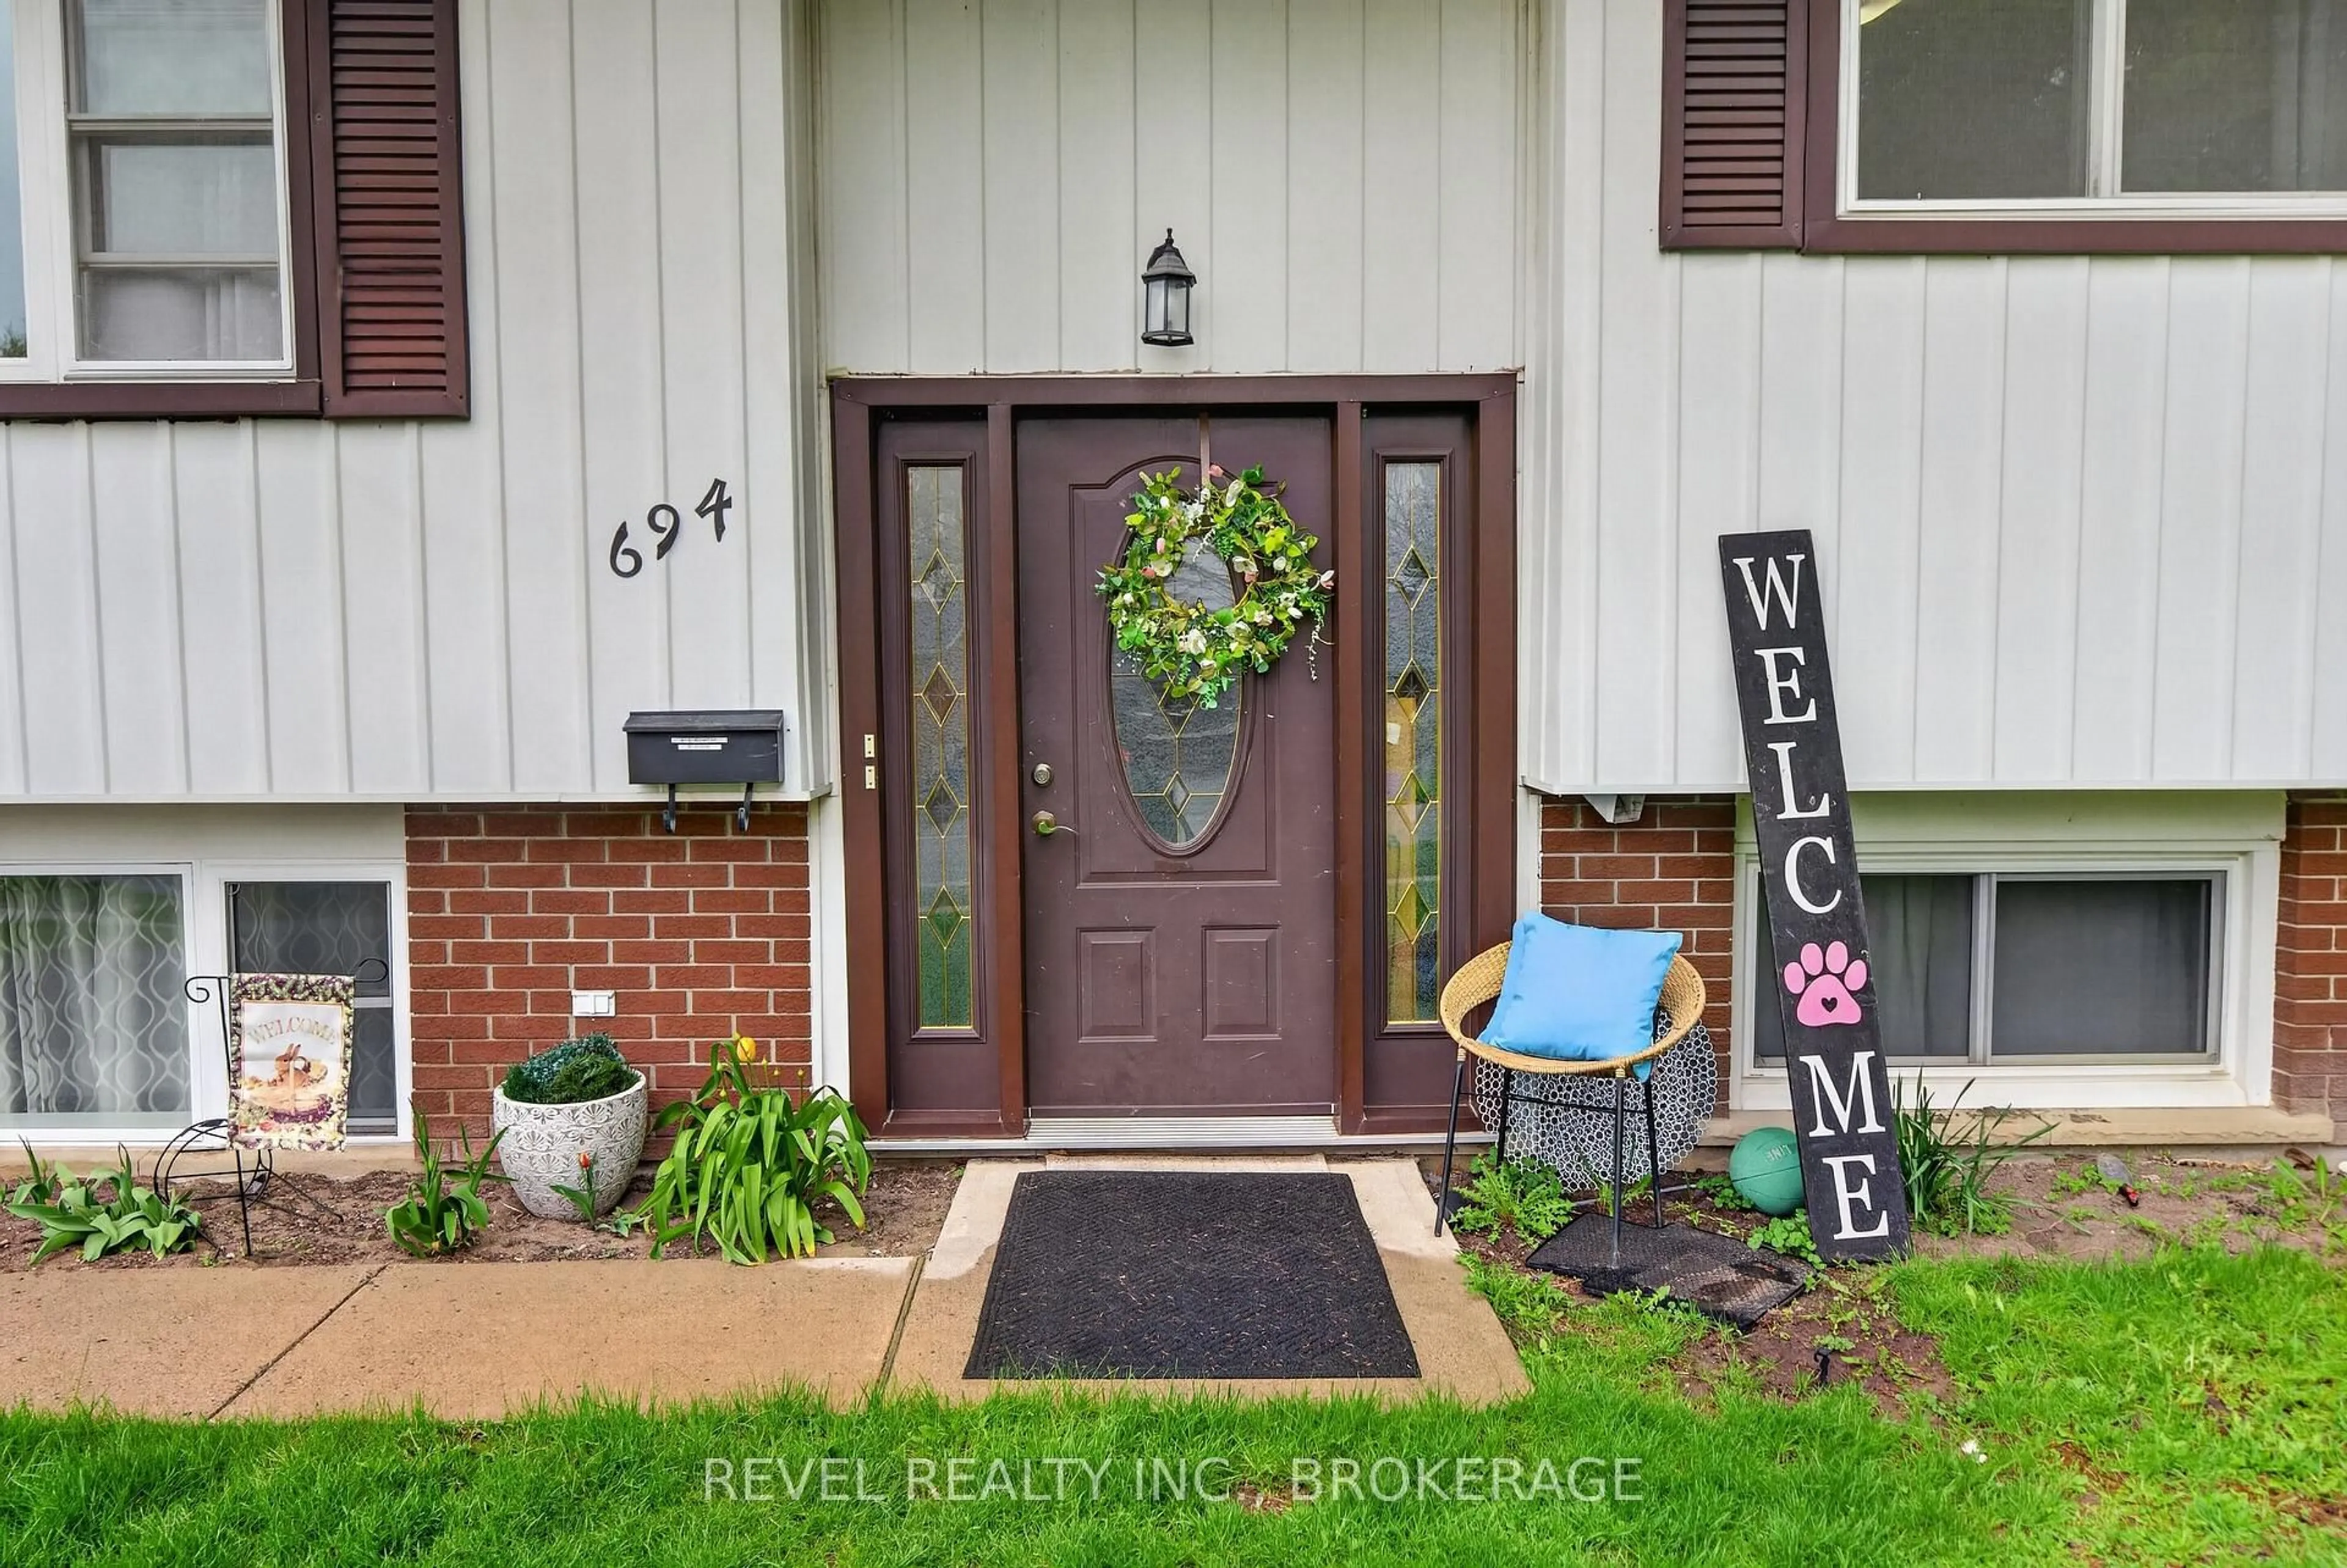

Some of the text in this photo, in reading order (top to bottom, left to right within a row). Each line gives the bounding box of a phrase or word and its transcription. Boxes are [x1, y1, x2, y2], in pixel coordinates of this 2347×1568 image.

[610, 478, 732, 578] 694
[1732, 554, 1889, 1240] WELCME
[247, 1016, 336, 1045] WELCOME
